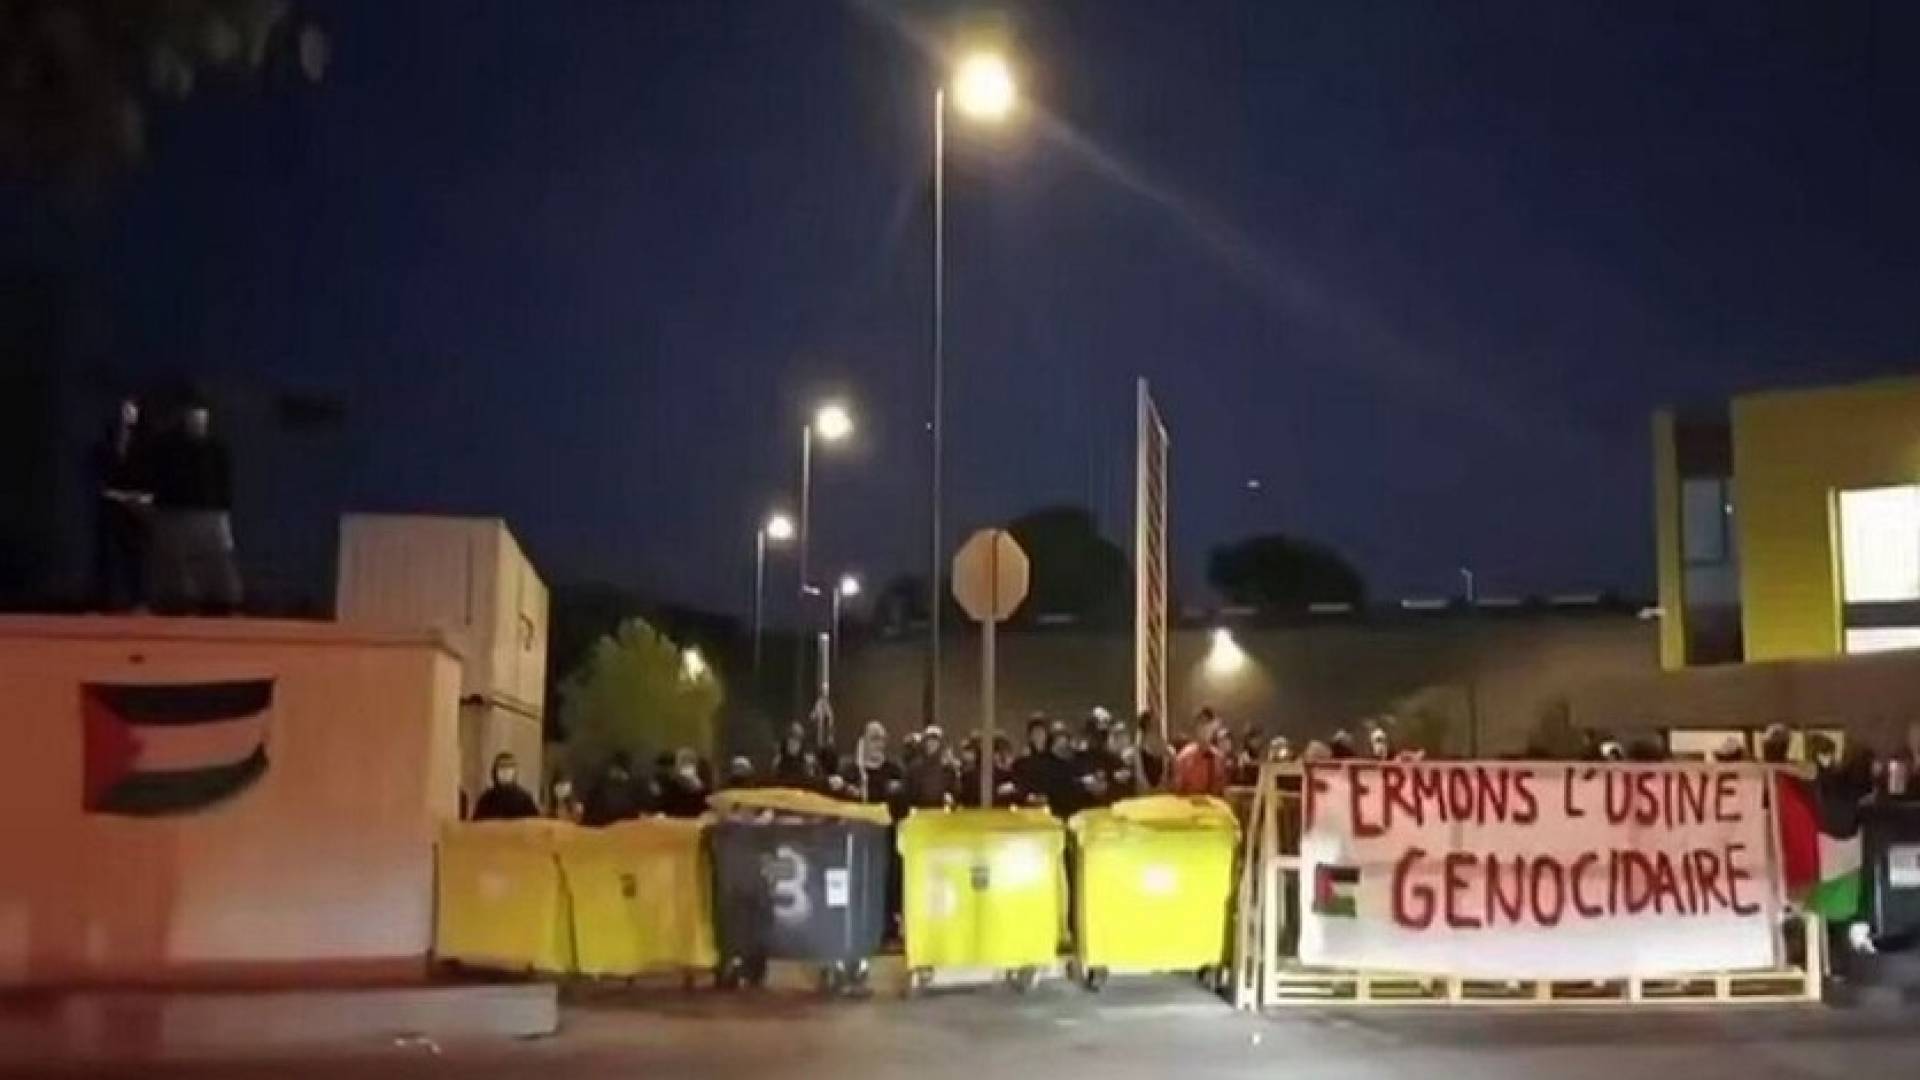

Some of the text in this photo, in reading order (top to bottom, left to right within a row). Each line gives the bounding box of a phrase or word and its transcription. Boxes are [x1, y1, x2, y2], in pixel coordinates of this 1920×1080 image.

[1304, 762, 1743, 838] FERMONS L'USINE
[773, 846, 813, 924] 3
[1391, 843, 1761, 930] GENOCIDAIRE
